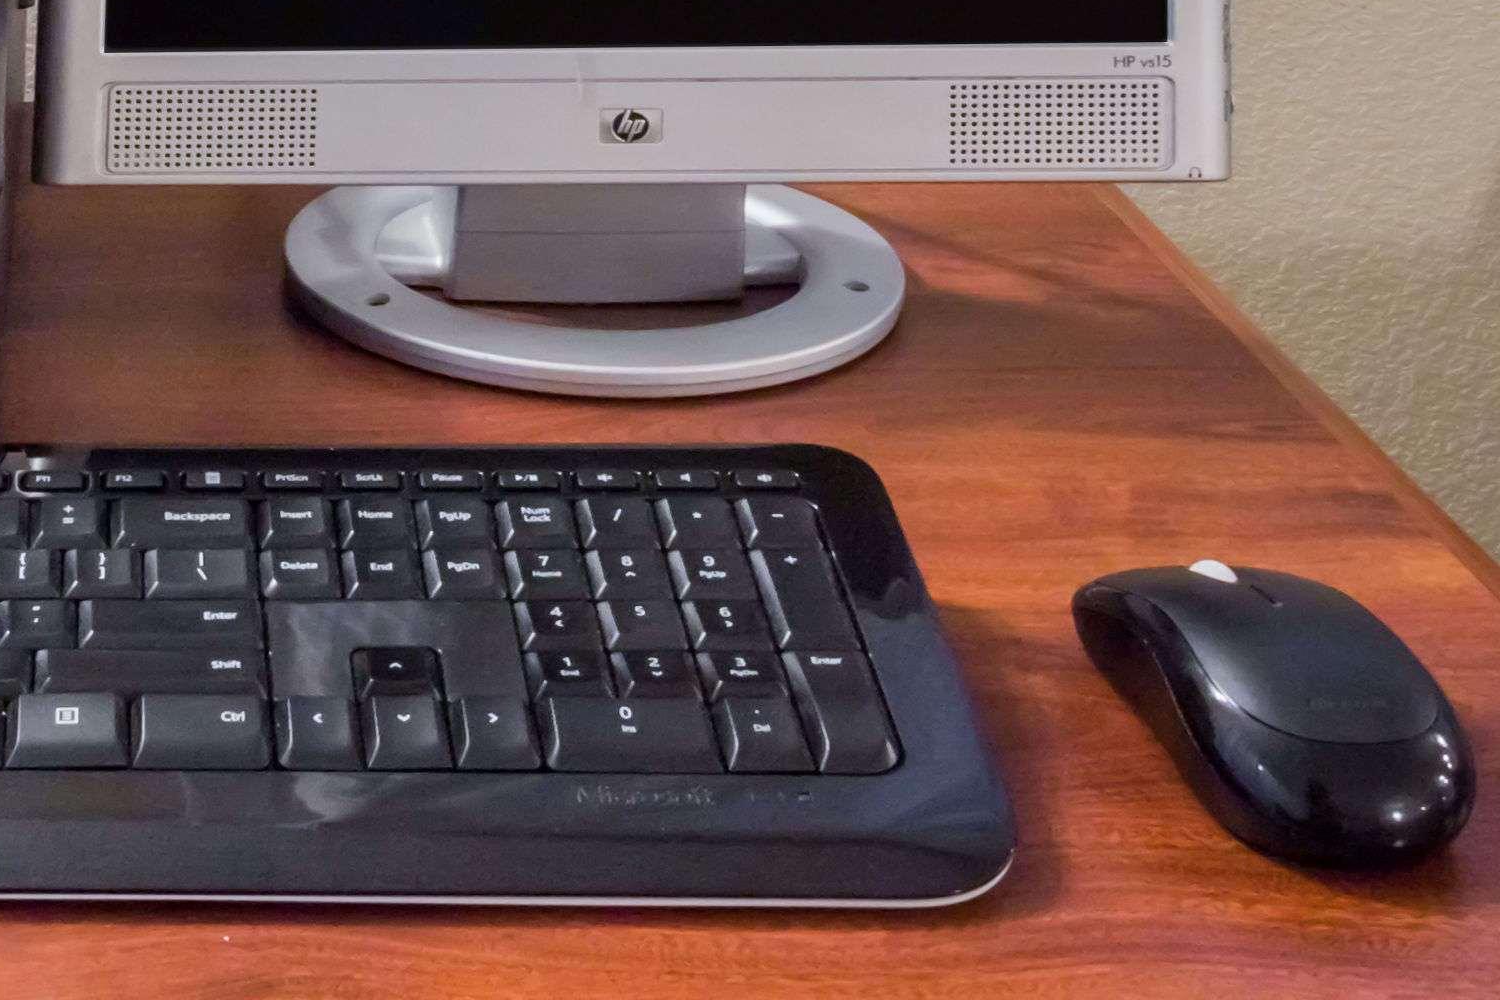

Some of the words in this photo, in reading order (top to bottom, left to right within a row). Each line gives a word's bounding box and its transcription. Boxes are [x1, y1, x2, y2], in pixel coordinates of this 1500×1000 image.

[1114, 56, 1136, 68] HP
[1140, 55, 1172, 68] vs15
[617, 108, 646, 142] hp
[63, 505, 74, 513] +
[521, 507, 550, 515] Num
[164, 512, 230, 522] Backspace
[439, 512, 471, 521] PgUp
[524, 514, 550, 522] Lock
[613, 509, 621, 521] /
[370, 562, 393, 570] End
[538, 556, 549, 566] 7
[621, 556, 633, 566] 8
[703, 556, 714, 566] 9
[447, 562, 480, 572] PgDn
[203, 611, 237, 620] Enter
[550, 607, 562, 616] 4
[635, 606, 645, 616] 5
[719, 607, 731, 617] 6
[211, 660, 241, 669] Shift
[563, 657, 571, 666] 1
[648, 657, 660, 667] 2
[735, 657, 746, 667] 3
[221, 711, 245, 722] Ctrl
